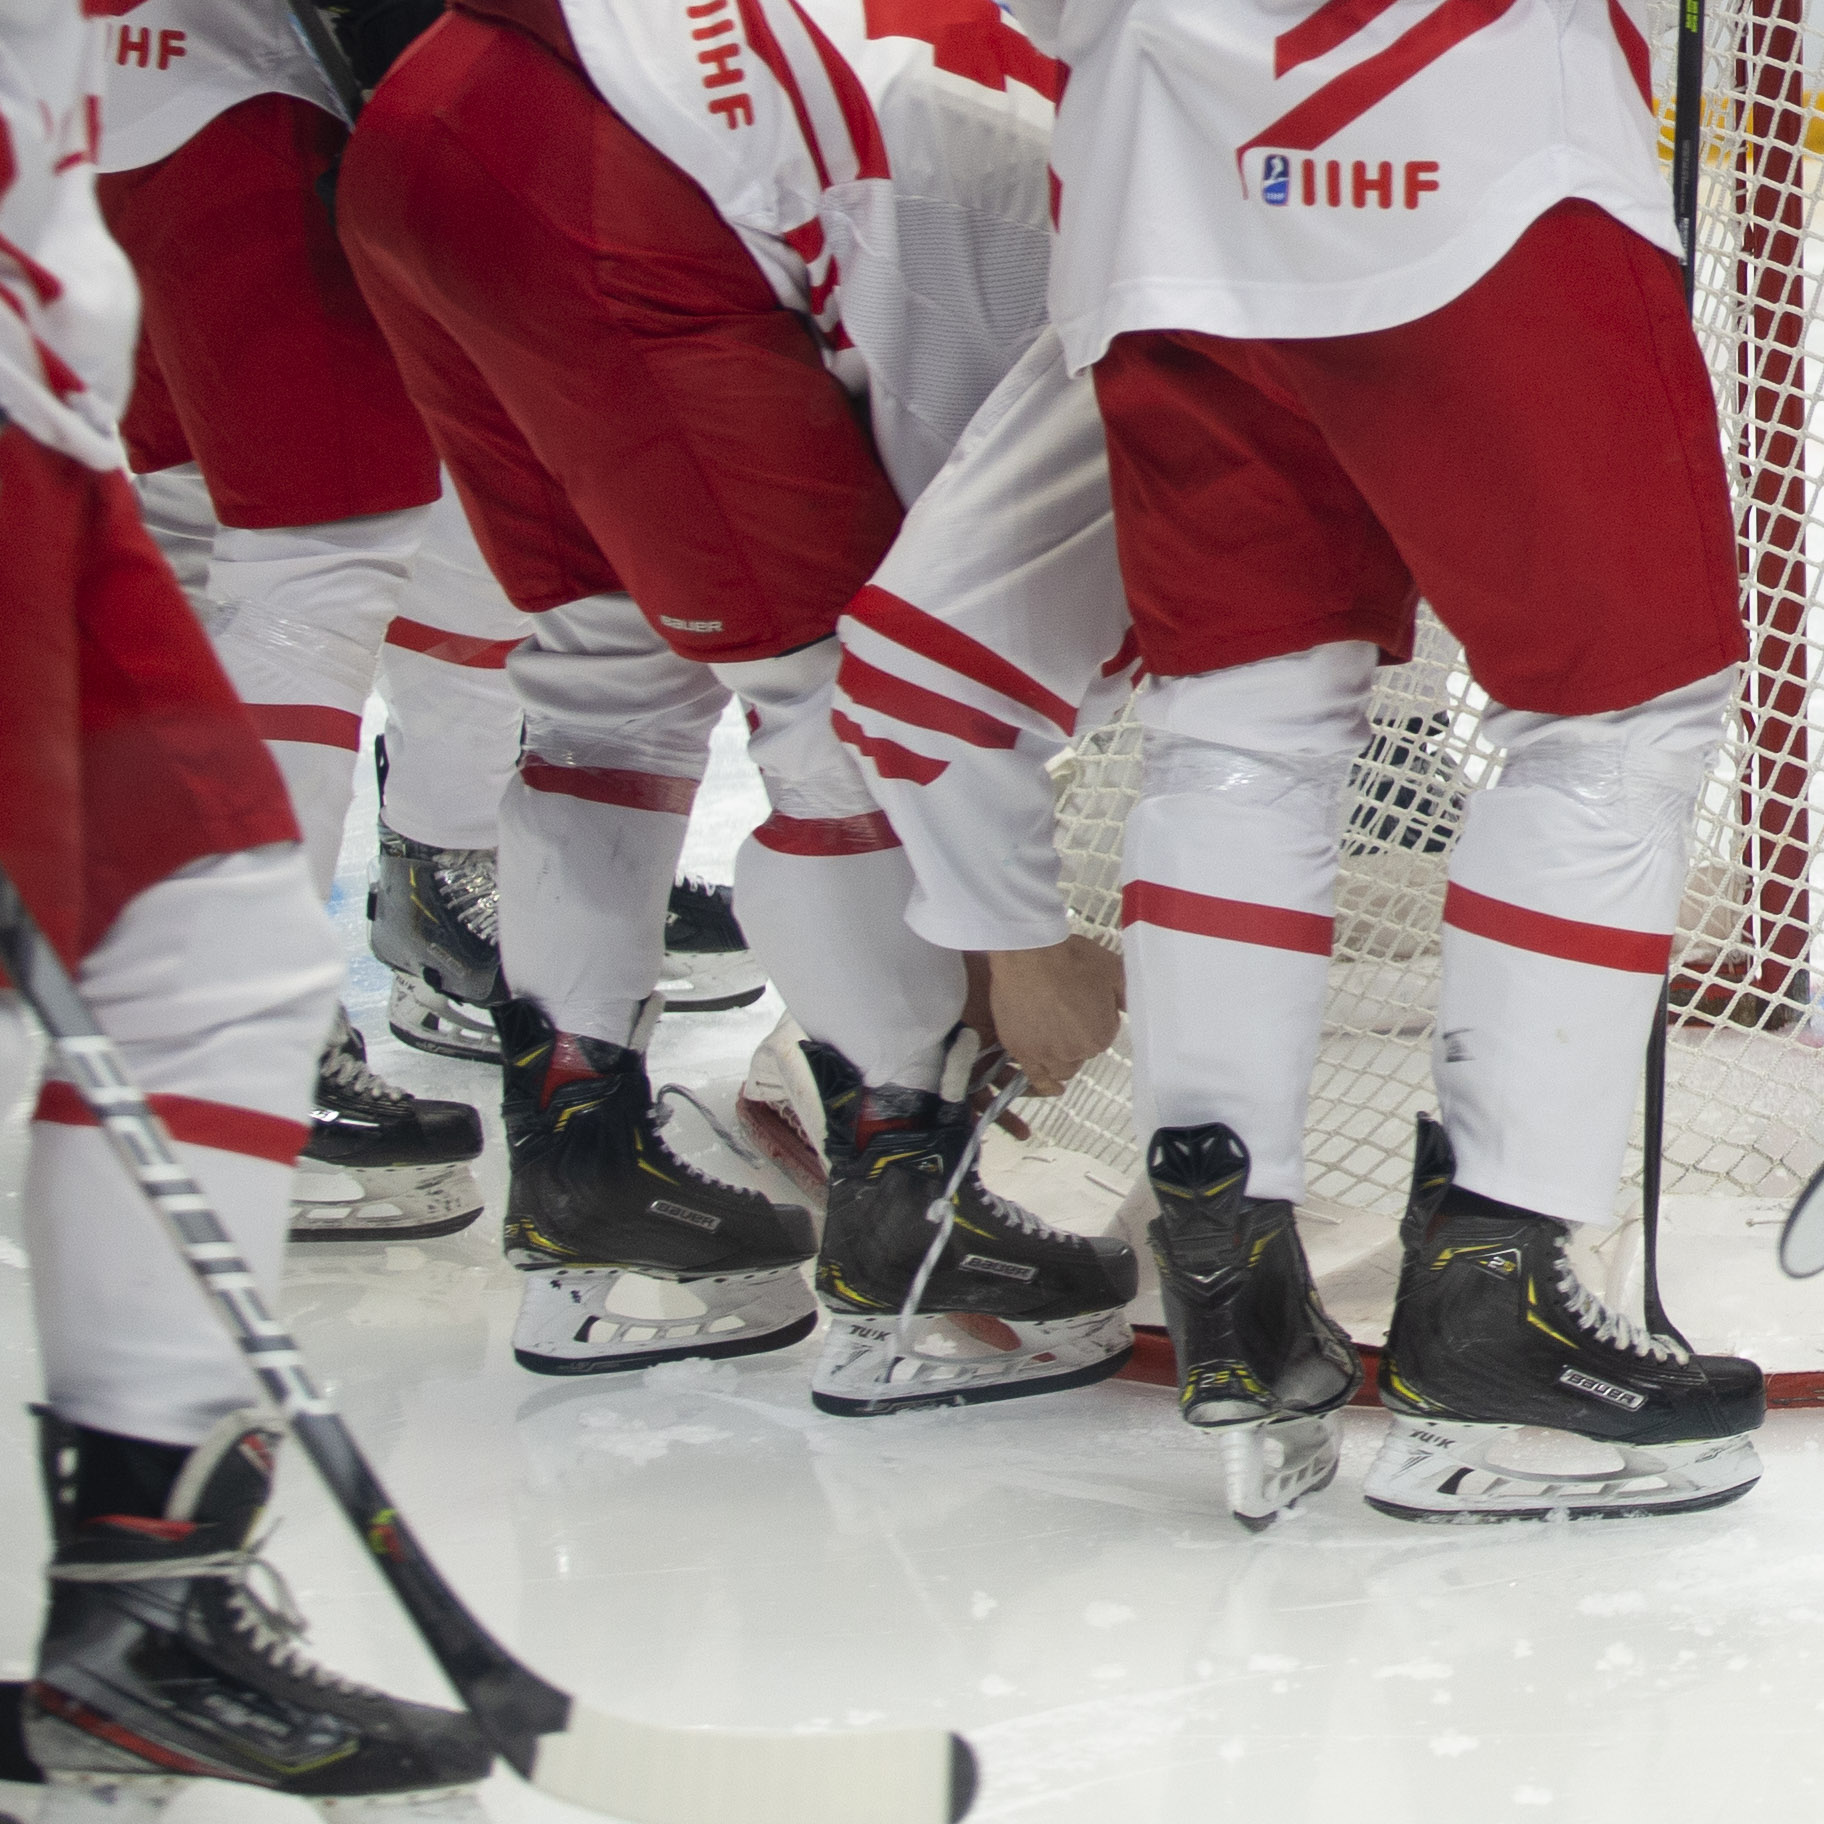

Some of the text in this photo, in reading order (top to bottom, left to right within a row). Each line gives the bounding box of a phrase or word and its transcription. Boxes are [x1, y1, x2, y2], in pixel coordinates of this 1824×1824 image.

[1300, 158, 1441, 211] IIHF
[659, 614, 724, 633] BAUER
[655, 1203, 718, 1230] BAUER
[1567, 1372, 1637, 1406] BAUER
